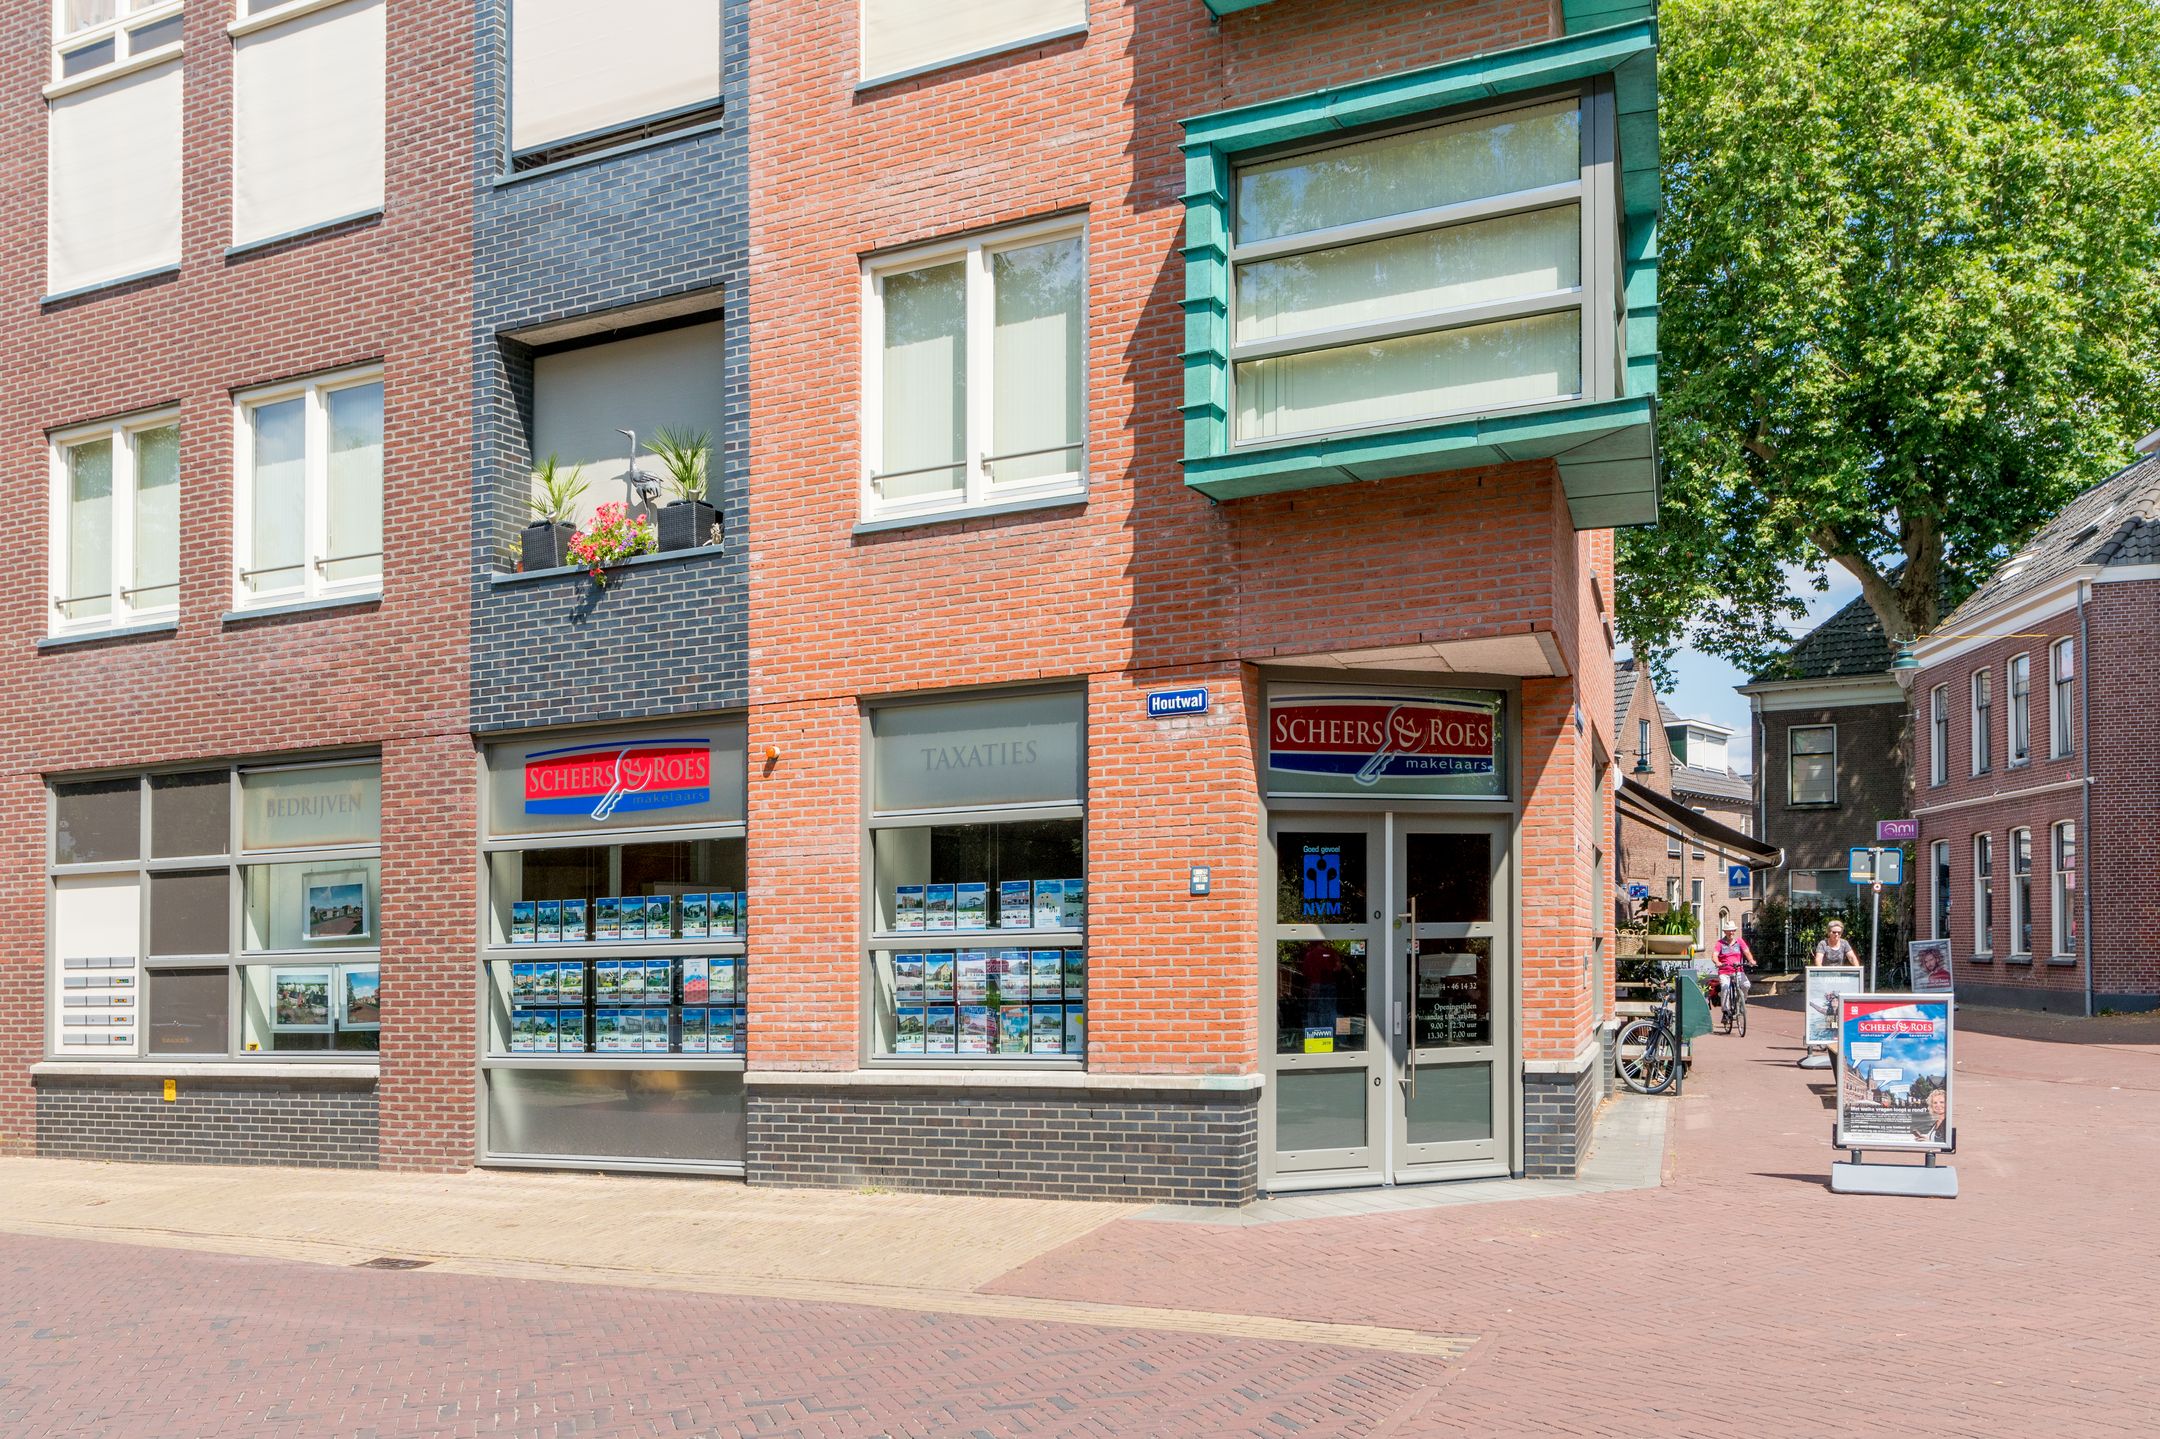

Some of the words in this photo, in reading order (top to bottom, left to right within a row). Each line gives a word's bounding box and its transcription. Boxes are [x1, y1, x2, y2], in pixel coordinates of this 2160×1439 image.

[1151, 692, 1203, 711] Houtwal
[1275, 714, 1383, 745] SCHEERS
[1393, 715, 1422, 748] &
[1429, 718, 1489, 747] ROES
[920, 739, 1038, 771] TAXATIES
[1405, 757, 1488, 770] makelaars
[529, 764, 615, 793] SCHEERS
[653, 756, 706, 783] ROES
[266, 792, 362, 819] BEDRIJVEN
[632, 791, 705, 805] makelaars
[1304, 902, 1340, 916] NVM
[1434, 1002, 1477, 1011] Openingstijden
[1860, 1022, 1896, 1031] SCHEERS
[1911, 1023, 1932, 1032] ROES
